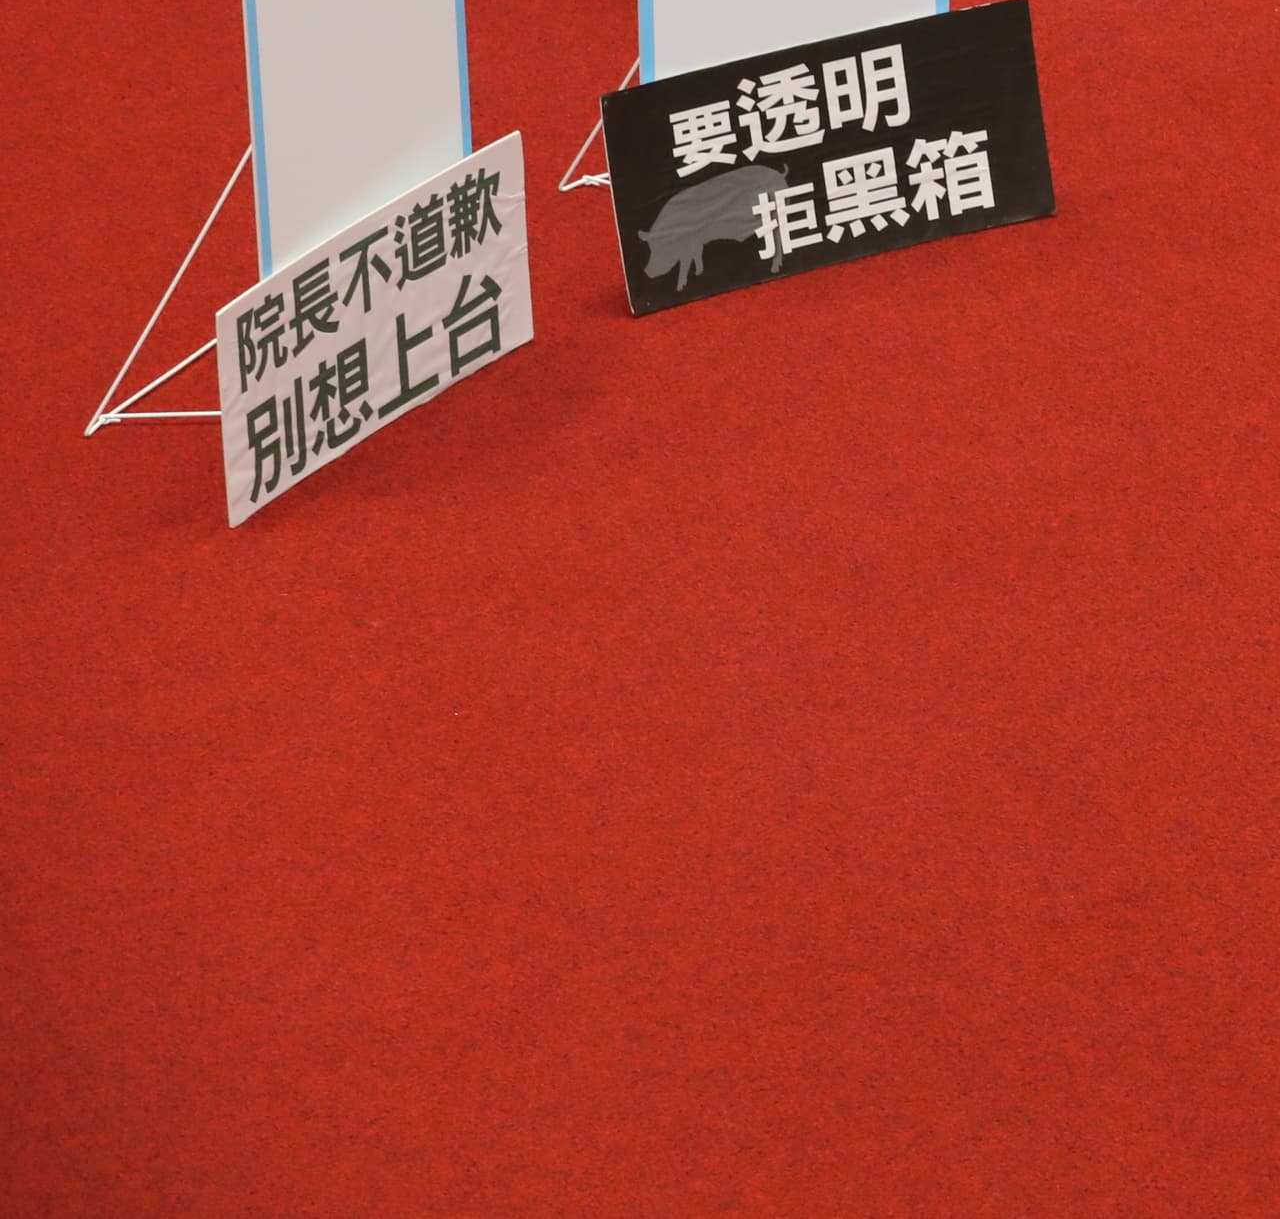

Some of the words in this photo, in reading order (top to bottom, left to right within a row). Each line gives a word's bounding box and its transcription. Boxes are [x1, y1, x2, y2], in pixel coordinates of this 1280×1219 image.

[669, 43, 914, 178] 要透明
[751, 130, 996, 260] 拒黑箱
[236, 167, 503, 393] 院長不道歉
[247, 274, 502, 503] 別想上台
